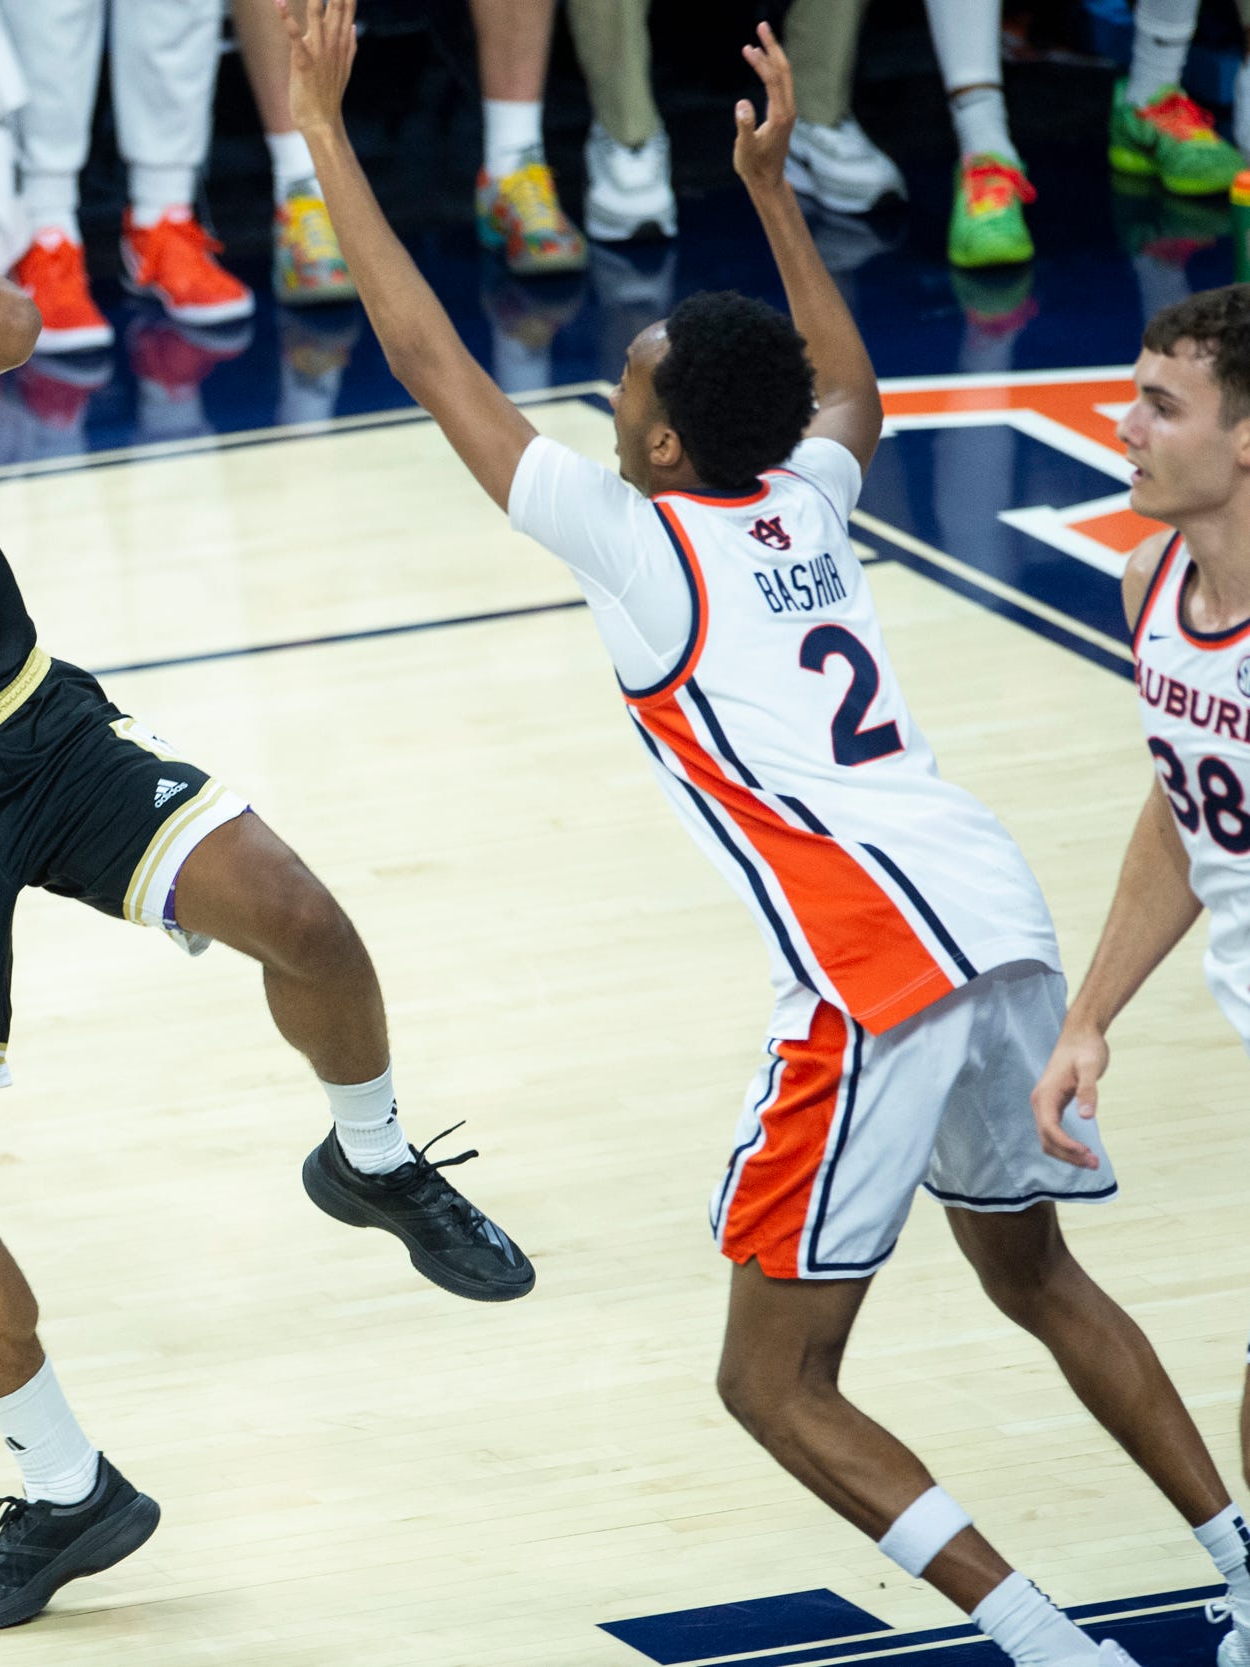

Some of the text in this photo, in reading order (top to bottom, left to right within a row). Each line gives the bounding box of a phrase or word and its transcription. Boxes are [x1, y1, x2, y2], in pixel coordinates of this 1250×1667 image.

[754, 552, 847, 613] BASHIR
[799, 623, 905, 768] 2
[1135, 659, 1250, 744] AUBUR
[154, 781, 189, 809] adidas
[1148, 736, 1250, 855] 38
